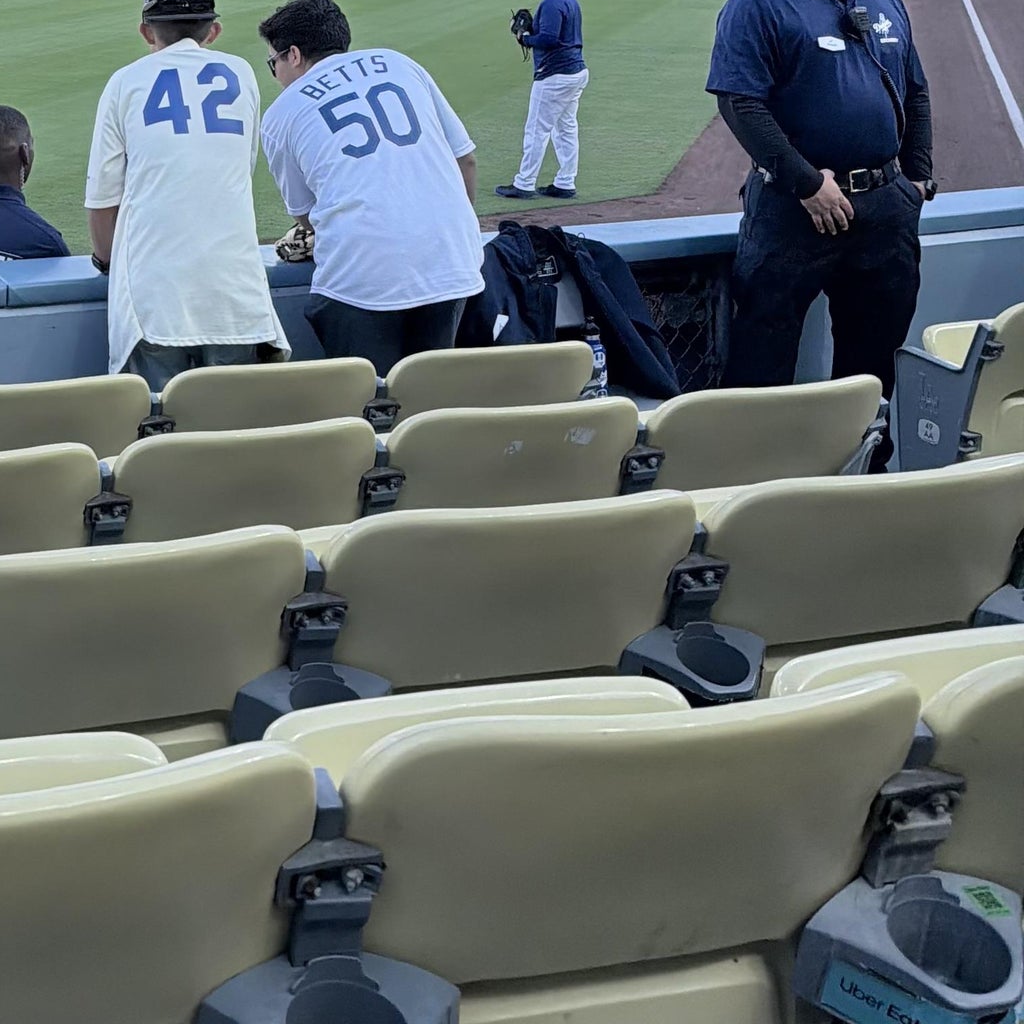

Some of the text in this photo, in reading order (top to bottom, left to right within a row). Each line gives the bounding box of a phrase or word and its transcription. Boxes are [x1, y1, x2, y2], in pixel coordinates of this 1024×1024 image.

[143, 62, 244, 136] 42
[299, 55, 388, 100] BETTS
[318, 81, 422, 159] 50
[839, 976, 920, 1024] Uber Ea
